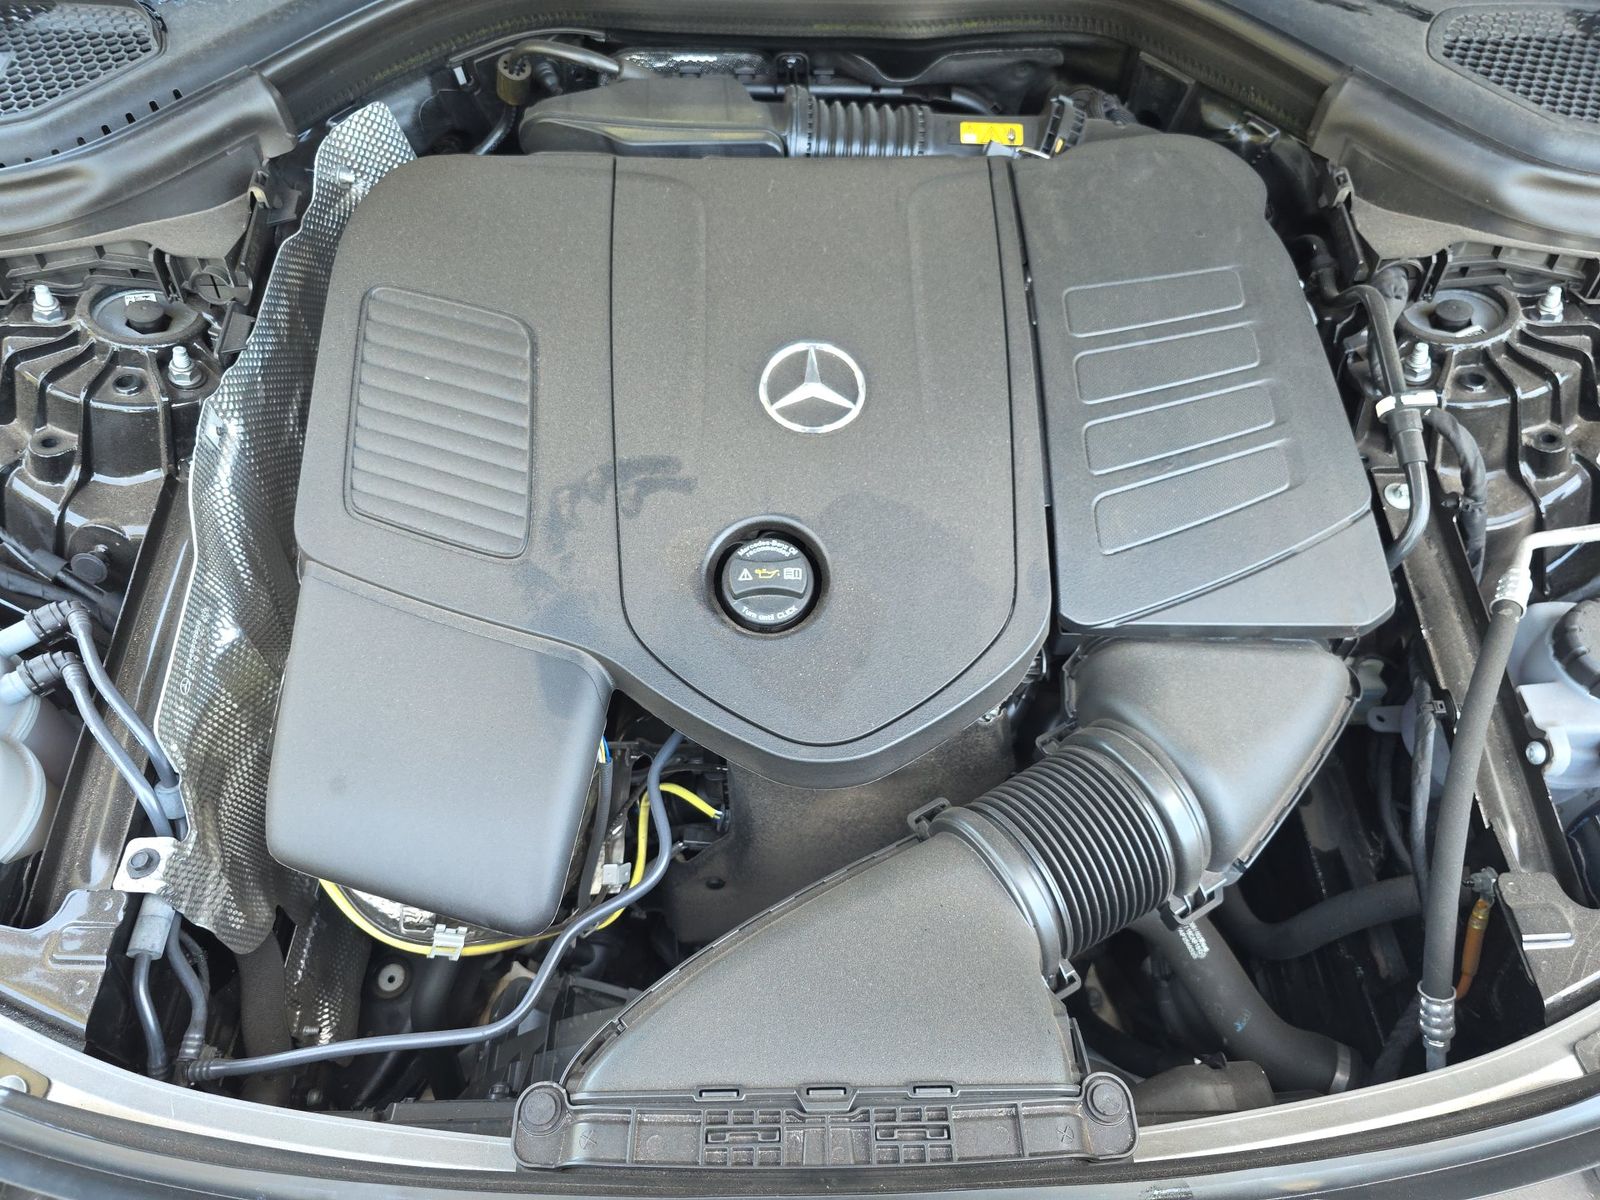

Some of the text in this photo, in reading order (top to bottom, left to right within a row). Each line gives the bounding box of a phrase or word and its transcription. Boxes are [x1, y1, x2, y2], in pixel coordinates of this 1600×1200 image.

[737, 540, 799, 557] Mercedes-Benz Oil
[746, 545, 790, 557] recommended
[742, 604, 798, 621] Turn until CLICK
